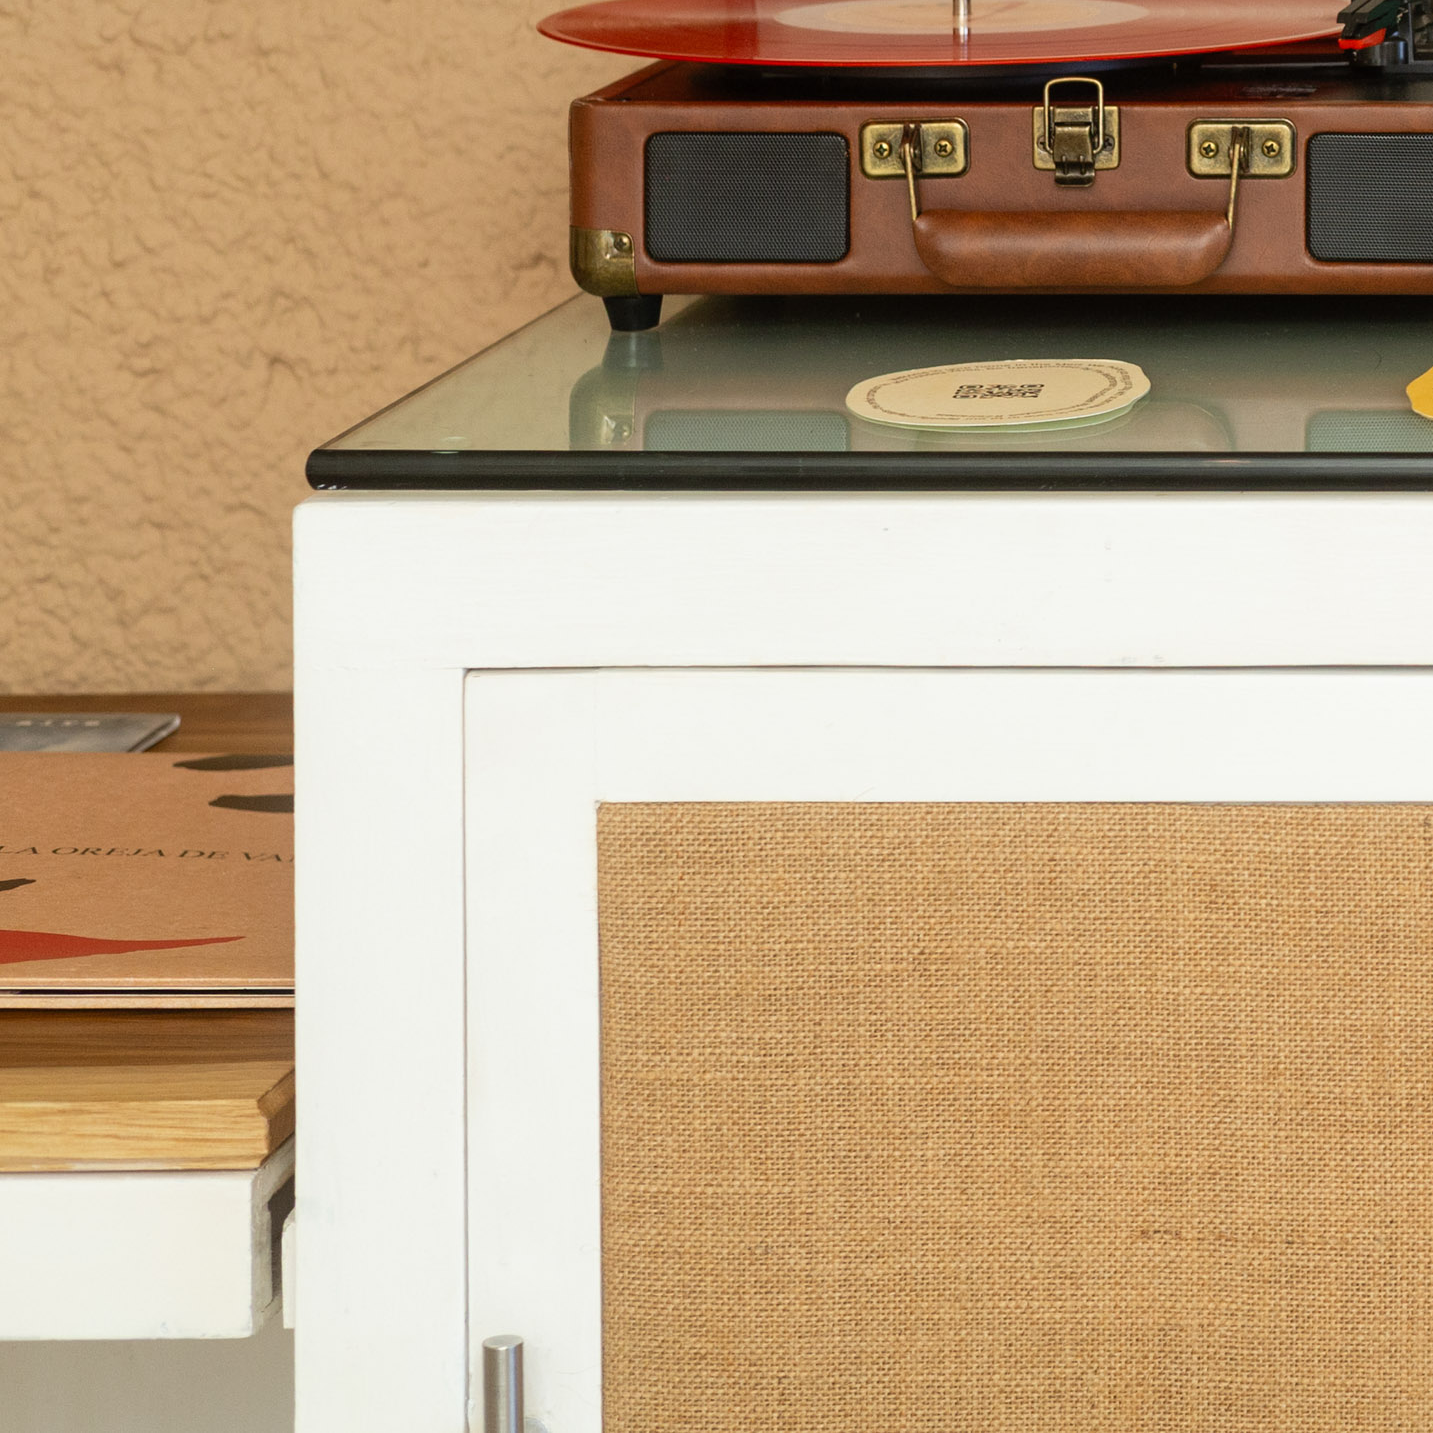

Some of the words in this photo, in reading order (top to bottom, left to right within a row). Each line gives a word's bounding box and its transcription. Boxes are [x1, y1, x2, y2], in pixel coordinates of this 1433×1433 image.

[0, 845, 39, 855] LA
[51, 846, 165, 858] OREJA
[178, 849, 228, 860] DE
[240, 851, 294, 862] VA
